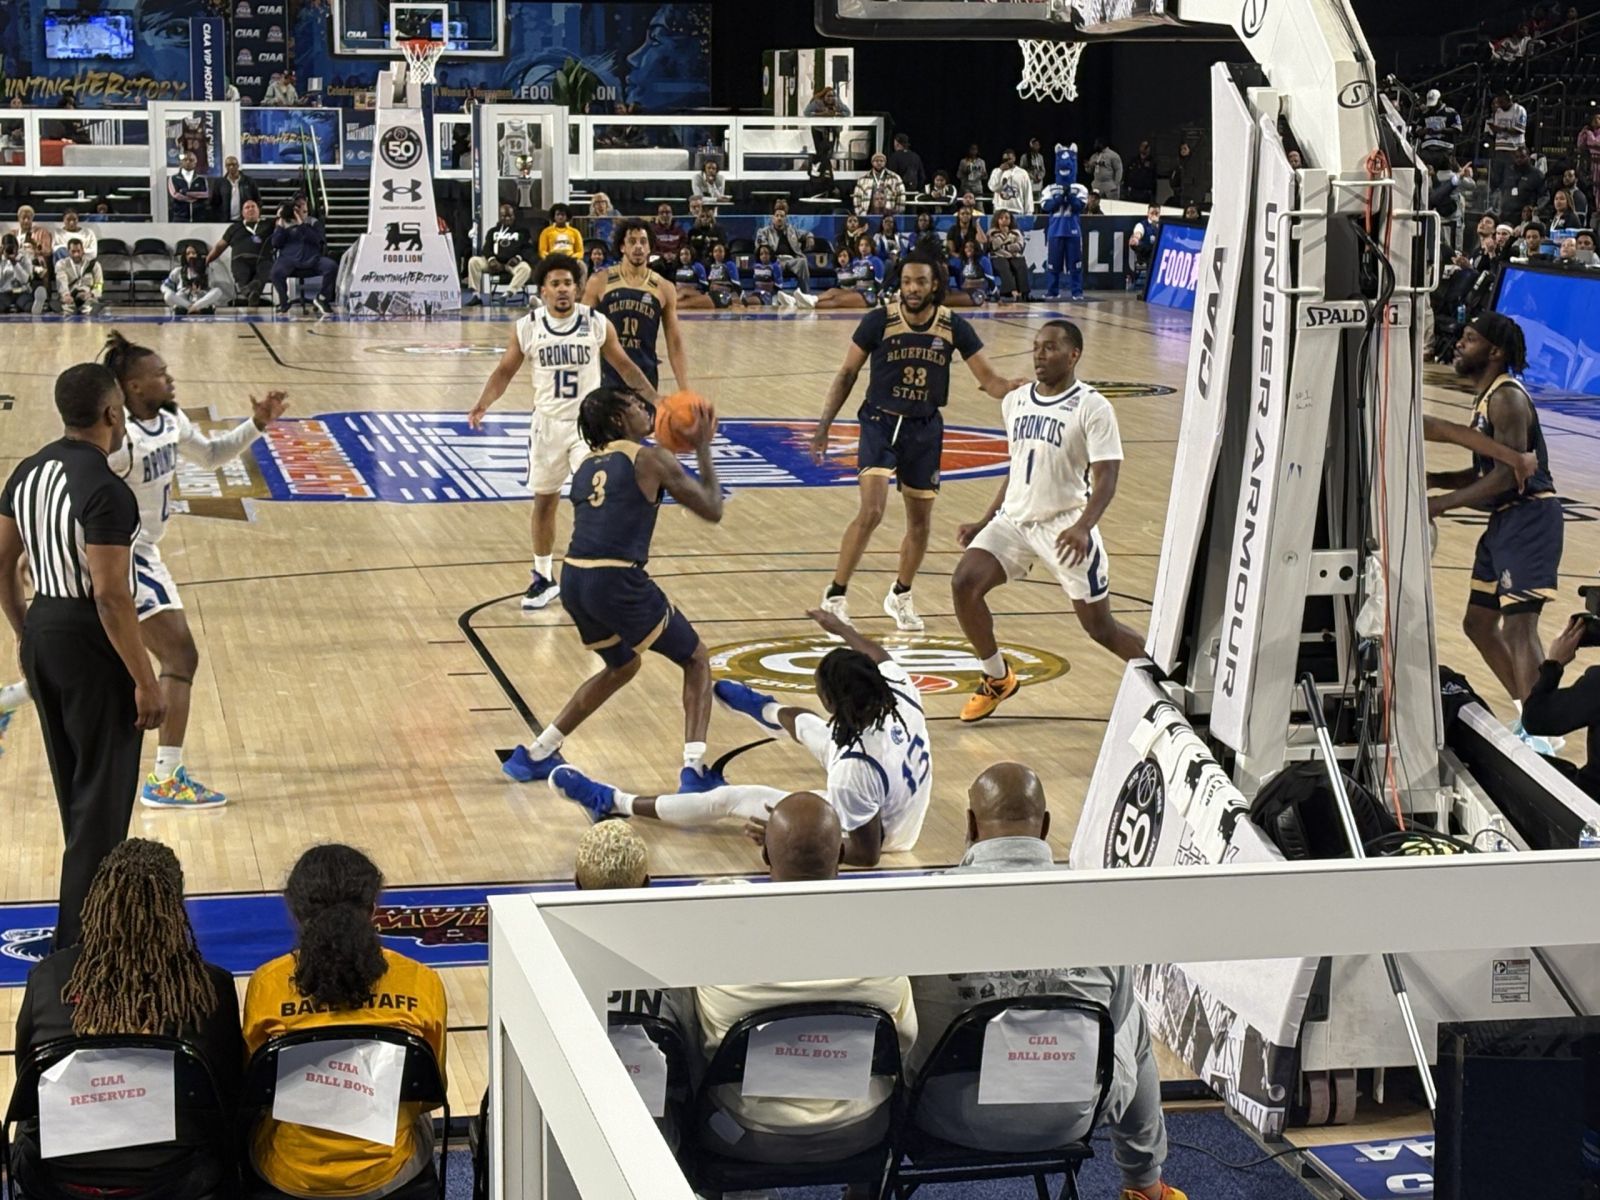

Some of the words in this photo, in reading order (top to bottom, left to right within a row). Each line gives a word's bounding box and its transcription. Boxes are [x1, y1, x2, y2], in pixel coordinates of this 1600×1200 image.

[257, 5, 283, 15] CIAA
[234, 28, 261, 38] CIAA
[258, 52, 284, 62] CIAA
[236, 75, 262, 85] CIAA
[388, 141, 415, 157] 50
[383, 254, 404, 264] FOOD
[405, 254, 423, 263] LION
[608, 299, 655, 319] BLUEFIELD
[1257, 202, 1278, 418] UNDER
[1306, 305, 1399, 328] SPALDG
[1198, 247, 1226, 400] CIAA
[539, 344, 591, 367] BRONCOS
[887, 347, 946, 366] BLUEFIELD
[554, 370, 578, 399] 15
[902, 366, 927, 387] 33
[1013, 415, 1066, 448] BRONCOS
[1025, 449, 1035, 485] 1
[588, 470, 608, 507] 3
[1221, 427, 1266, 698] ARMOUR
[1115, 803, 1151, 867] 50
[798, 1033, 830, 1044] CIAA
[1028, 1035, 1058, 1046] CIAA
[775, 1046, 810, 1057] BALL
[812, 1048, 848, 1059] BOYS
[1007, 1051, 1041, 1061] BALL
[1042, 1051, 1077, 1061] BOYS
[328, 1060, 360, 1076] CIAA
[90, 1074, 126, 1088] CIAA
[305, 1071, 341, 1088] BALL
[343, 1078, 375, 1097] BOYS
[70, 1087, 147, 1107] RESERVED
